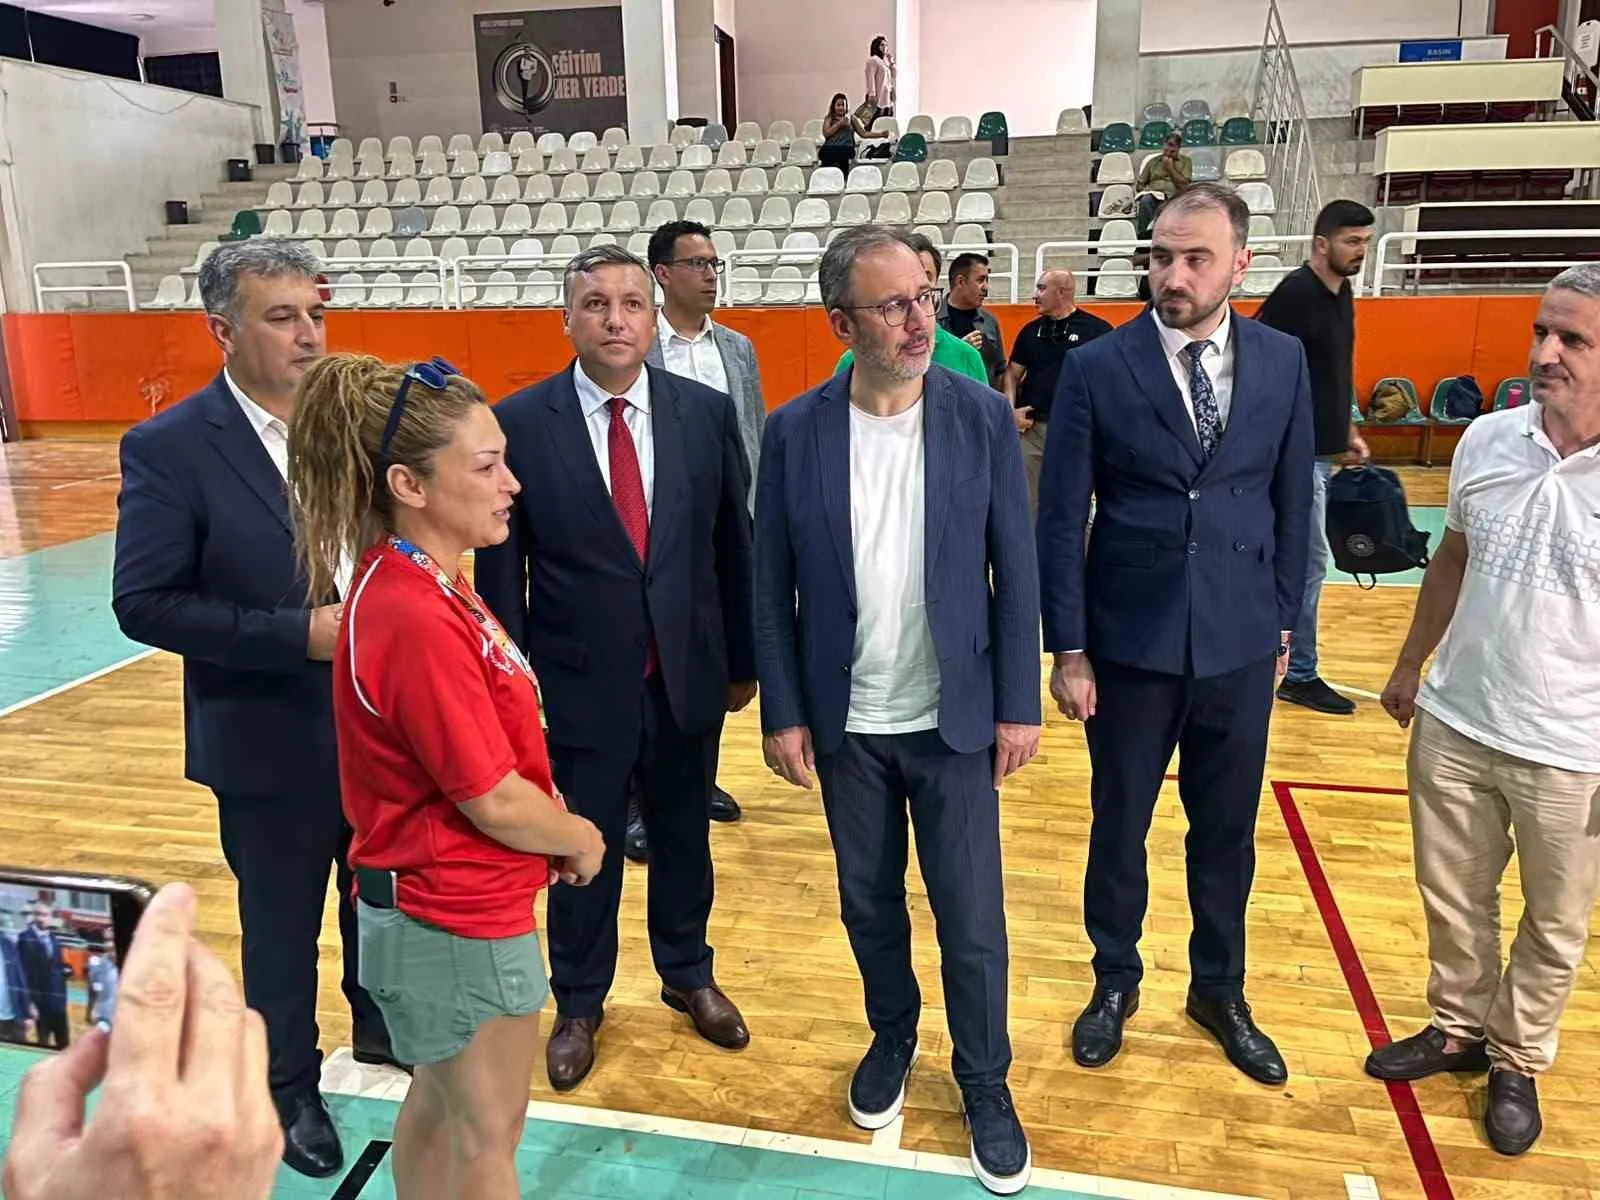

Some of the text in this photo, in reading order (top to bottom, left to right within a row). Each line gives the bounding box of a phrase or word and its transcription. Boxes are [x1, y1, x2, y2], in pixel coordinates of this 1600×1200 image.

[552, 50, 601, 75] EĞİTİM
[553, 75, 625, 98] HER YERDE
